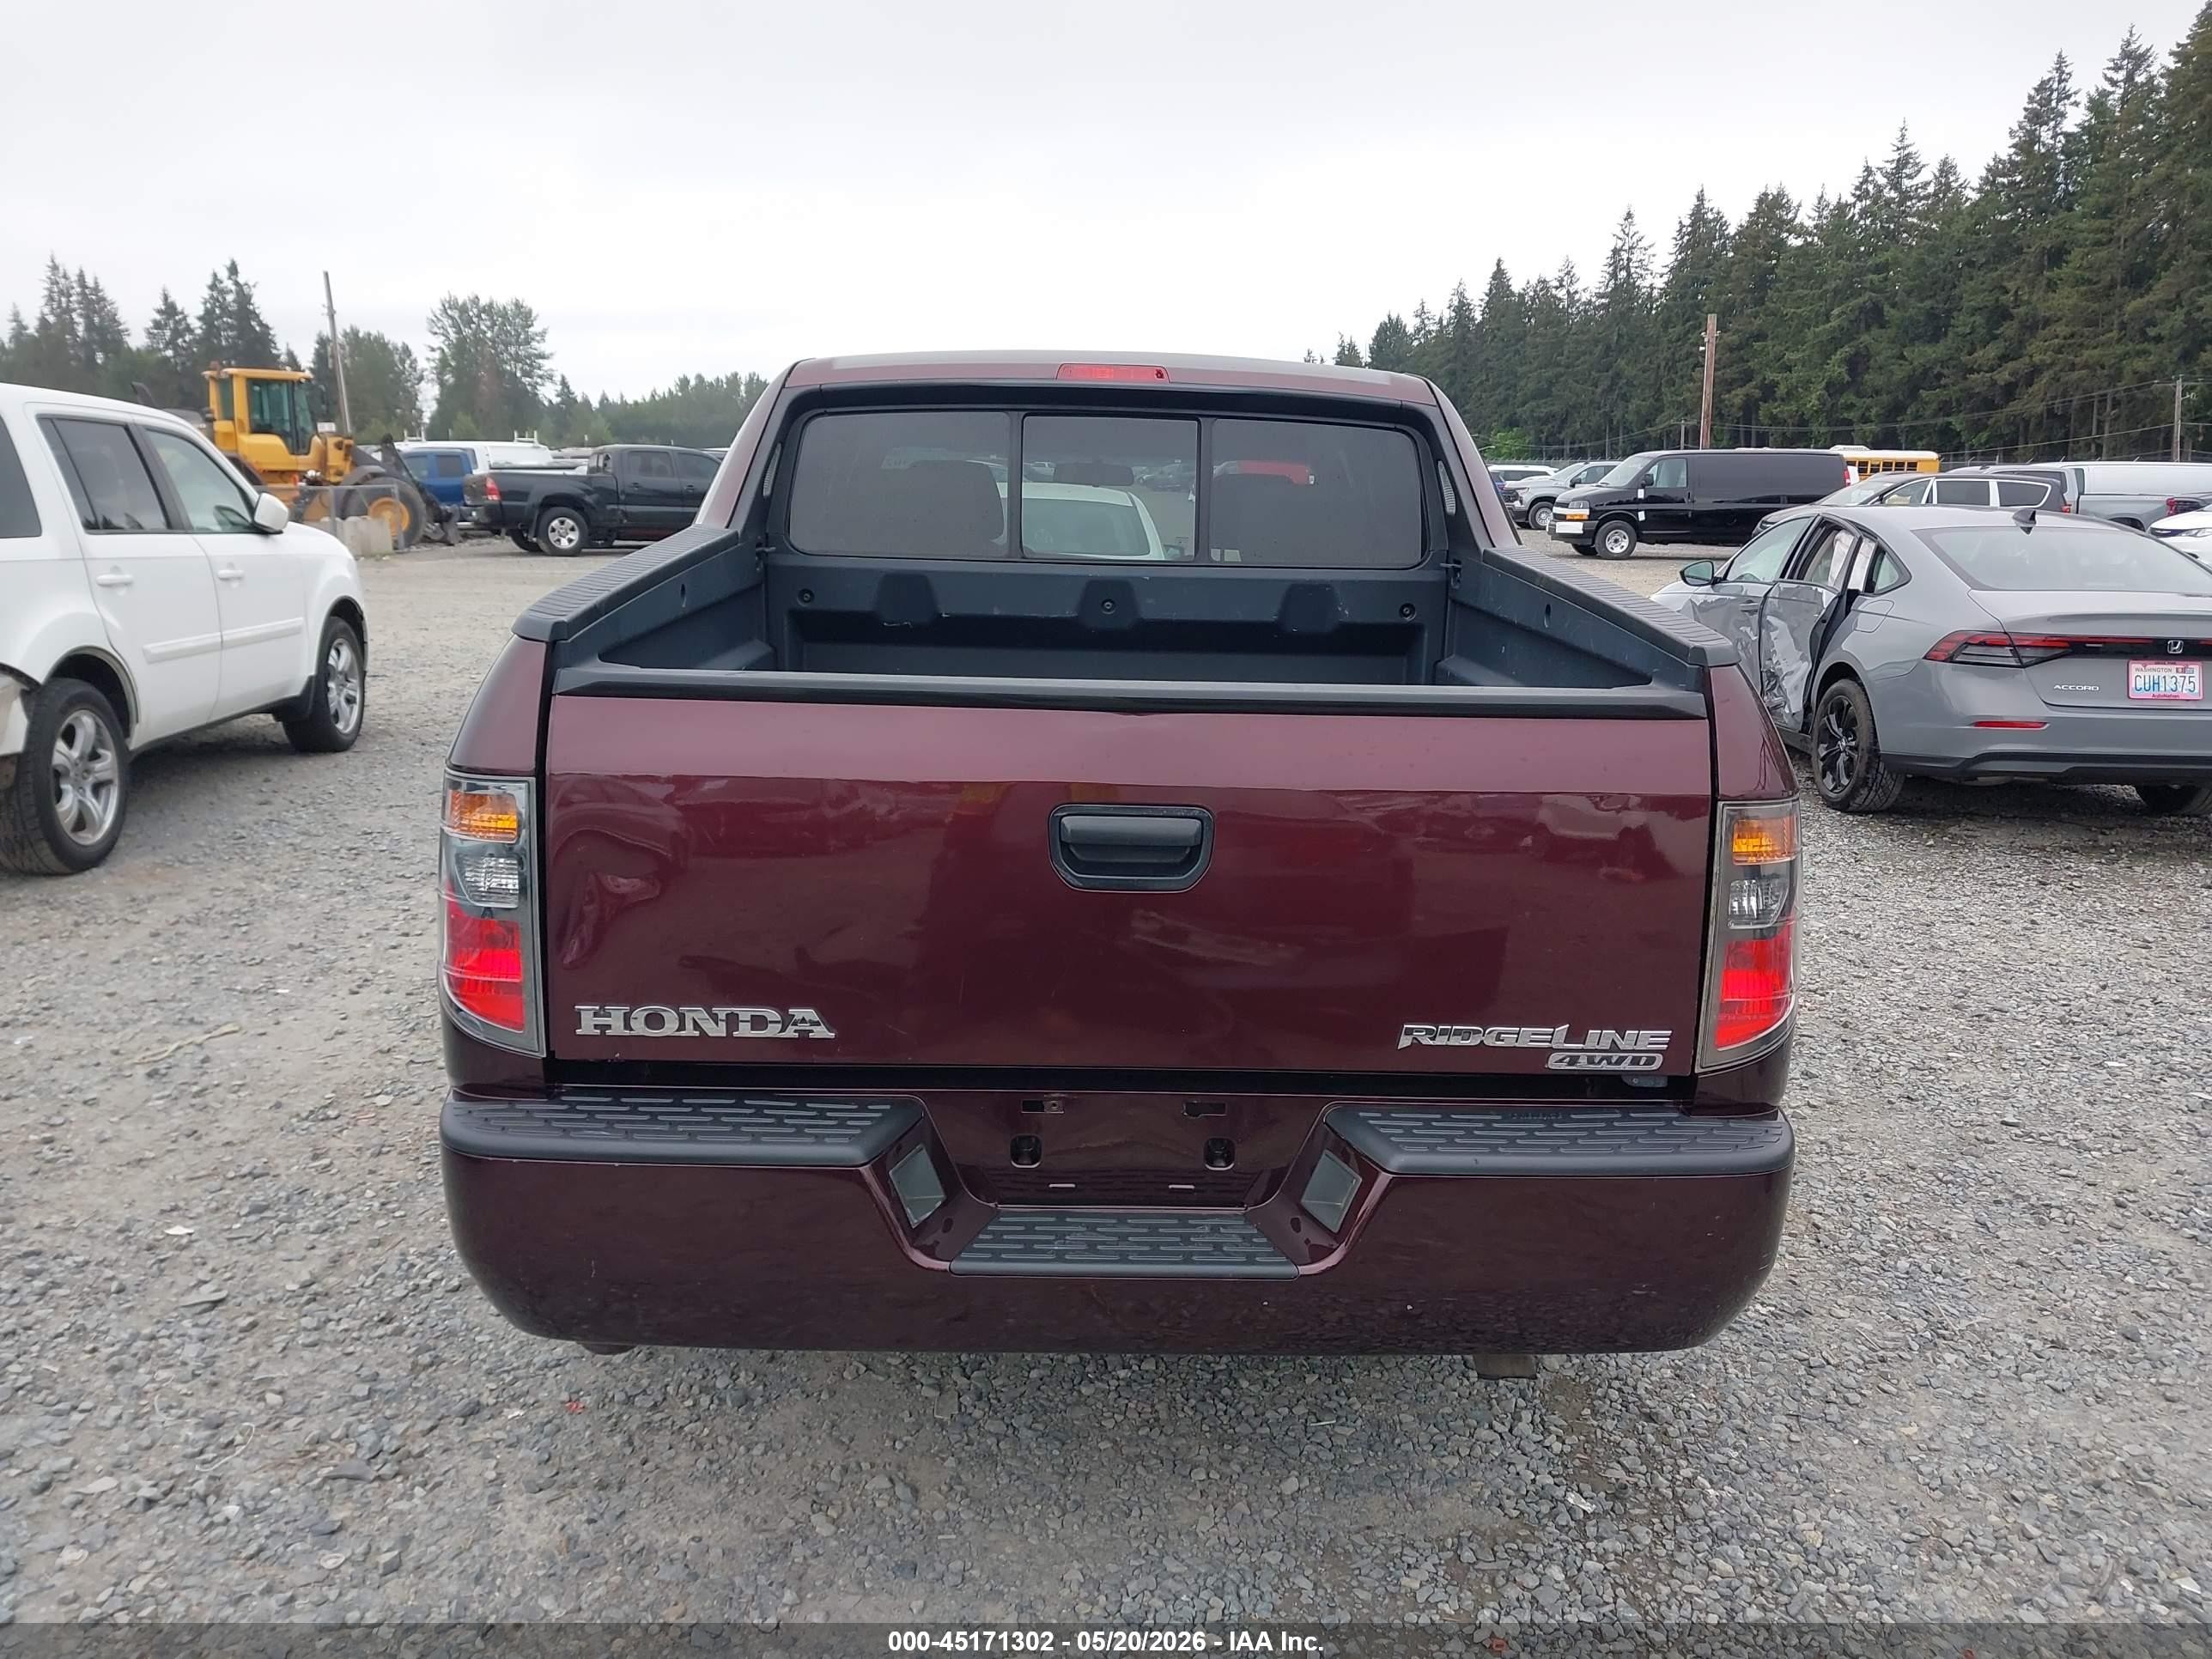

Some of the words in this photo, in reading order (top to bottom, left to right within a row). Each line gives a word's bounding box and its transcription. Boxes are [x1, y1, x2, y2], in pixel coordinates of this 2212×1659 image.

[2134, 674, 2196, 693] CUH1375
[574, 1006, 836, 1039] HONDA
[1397, 1024, 1673, 1050] RIDGELINE
[1549, 1054, 1661, 1069] 4WD
